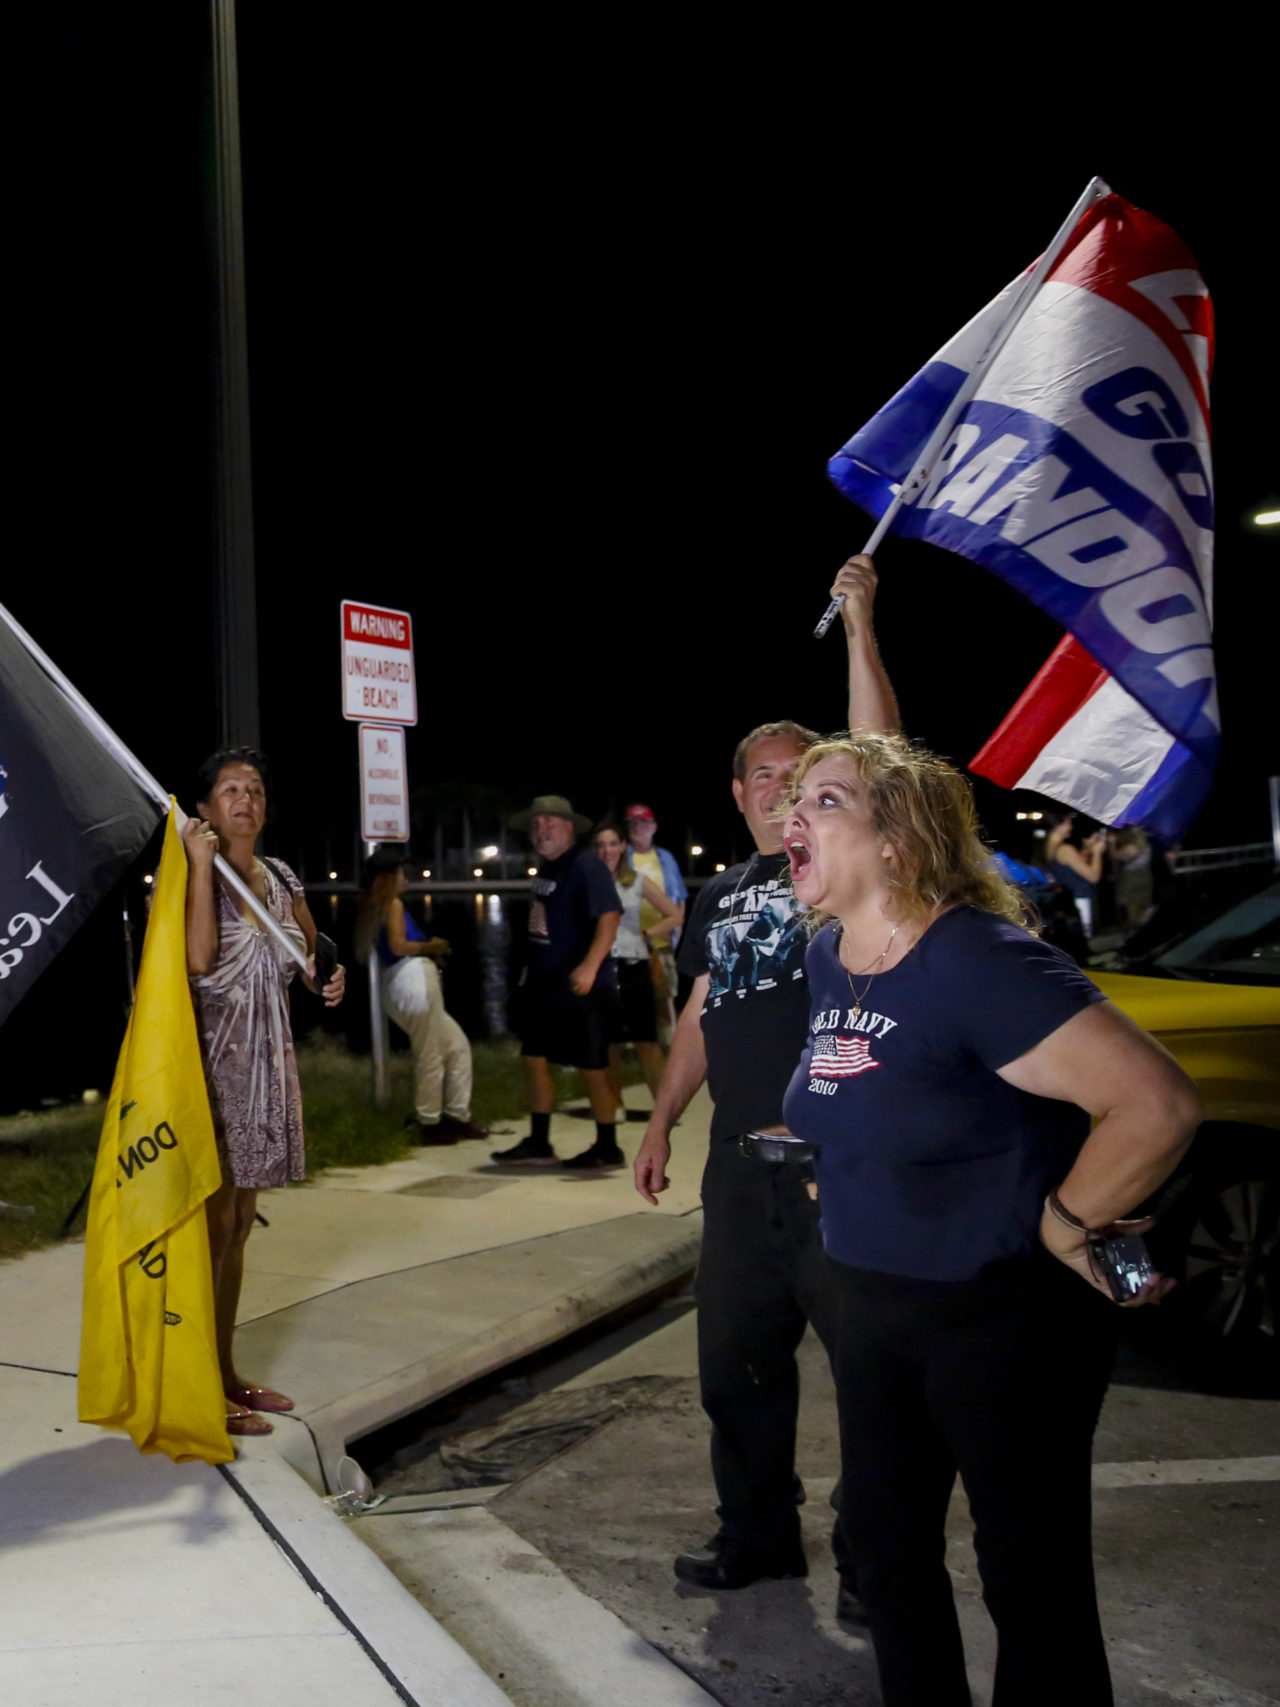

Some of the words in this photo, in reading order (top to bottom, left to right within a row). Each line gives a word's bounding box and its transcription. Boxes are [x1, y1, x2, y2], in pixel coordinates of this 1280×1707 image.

[1081, 366, 1213, 532] GO
[888, 423, 1214, 688] RANDO
[350, 611, 406, 641] WARNING
[347, 655, 410, 684] UNGUARDED
[363, 686, 398, 710] BEACH
[812, 1009, 840, 1034] OLD
[843, 1009, 898, 1039] NAVY
[808, 1078, 838, 1096] 2010
